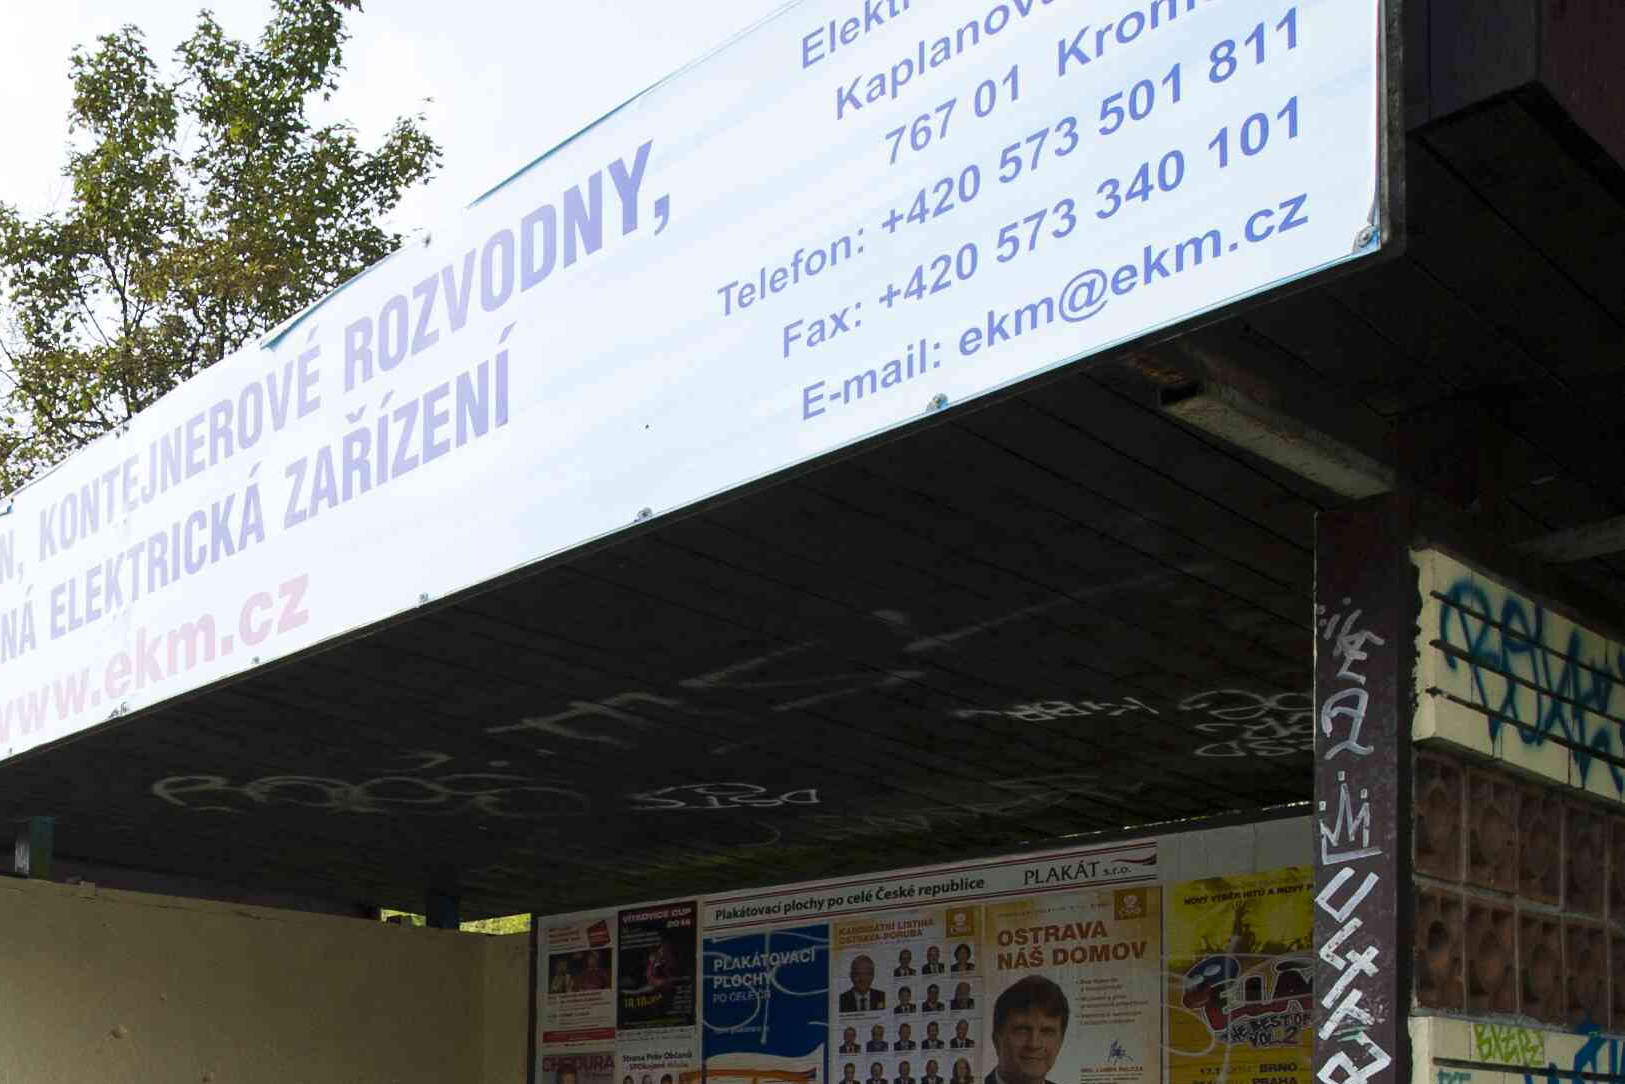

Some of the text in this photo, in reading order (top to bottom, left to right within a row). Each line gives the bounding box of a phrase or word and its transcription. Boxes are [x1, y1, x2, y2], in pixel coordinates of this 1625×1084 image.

[836, 0, 1056, 120] Kaplanov
[885, 98, 958, 164] 767
[975, 64, 1020, 118] 01
[717, 7, 1299, 316] Telefon: +420 573 501 811
[782, 96, 1300, 358] Fax: +420 573 340 101
[39, 327, 322, 562] KONTEJNEROVÉ
[343, 138, 671, 394] ROZVODNY,
[802, 193, 1309, 420] E-mail: ekm@ekm.cz
[49, 462, 265, 641] ELEKTRICKÁ
[282, 321, 518, 531] ZAŘÍZENÍ
[714, 901, 783, 921] Plakátovací
[783, 896, 825, 915] plochy
[827, 896, 844, 909] po
[846, 890, 872, 904] celé
[875, 884, 915, 901] České
[917, 877, 986, 898] republice
[1023, 859, 1102, 886] PLAKÁT
[997, 920, 1109, 947] OSTRAVA
[712, 972, 772, 990] PLOCHY
[997, 942, 1148, 971] NÁŠ DOMOV
[1259, 1062, 1297, 1073] BRNO
